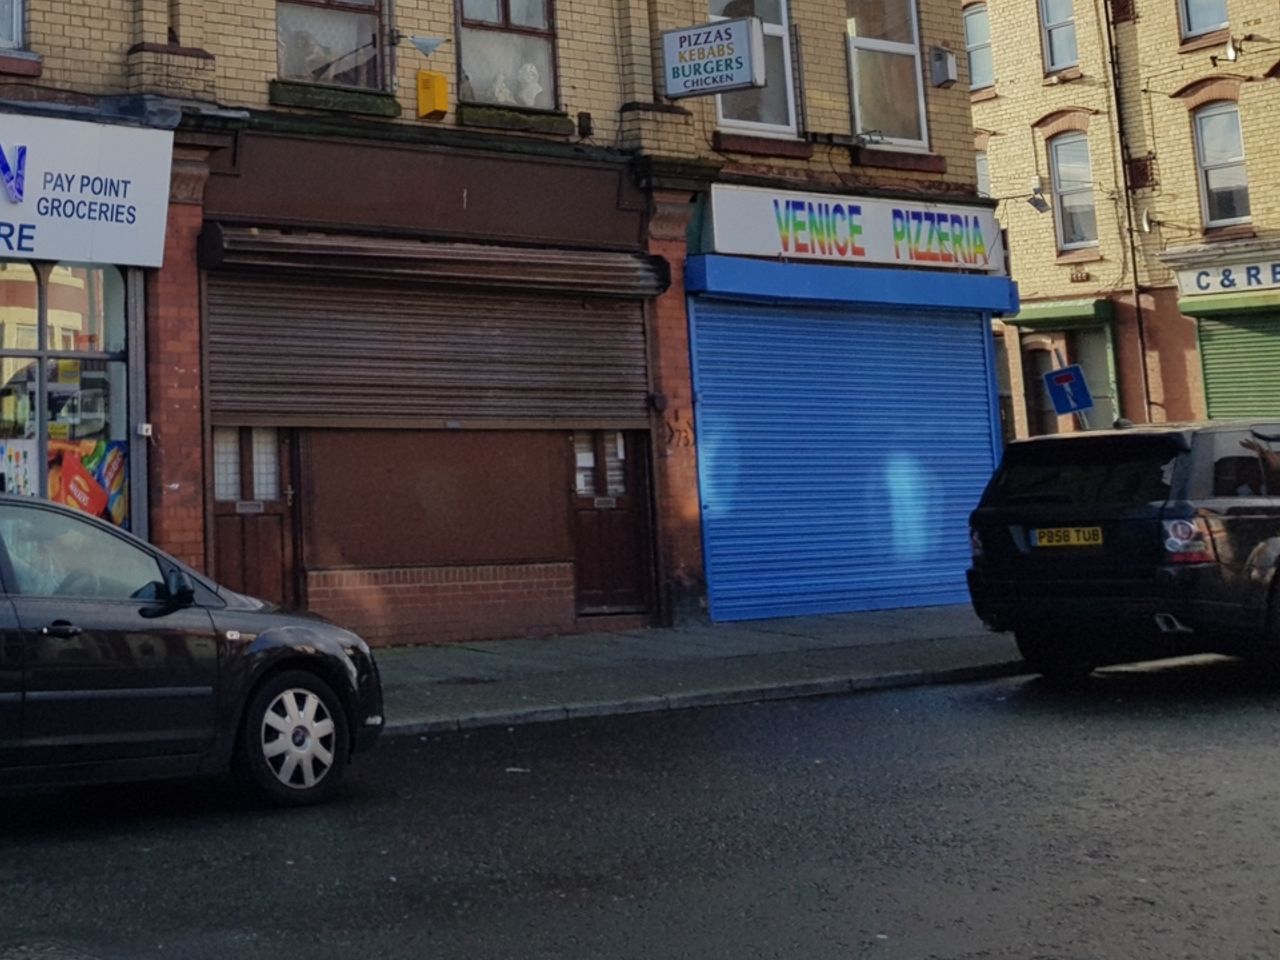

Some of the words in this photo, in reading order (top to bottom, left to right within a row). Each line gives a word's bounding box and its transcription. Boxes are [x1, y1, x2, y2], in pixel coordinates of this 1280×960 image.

[679, 27, 732, 48] PIZZAS
[677, 42, 735, 63] KEBABS
[671, 56, 744, 79] BURGERS
[683, 73, 734, 89] CHICKEN
[42, 171, 75, 195] PAY
[79, 174, 131, 200] POINT
[36, 196, 137, 225] GROCERIES
[772, 198, 866, 258] VENICE
[891, 208, 989, 265] PIZZERIA
